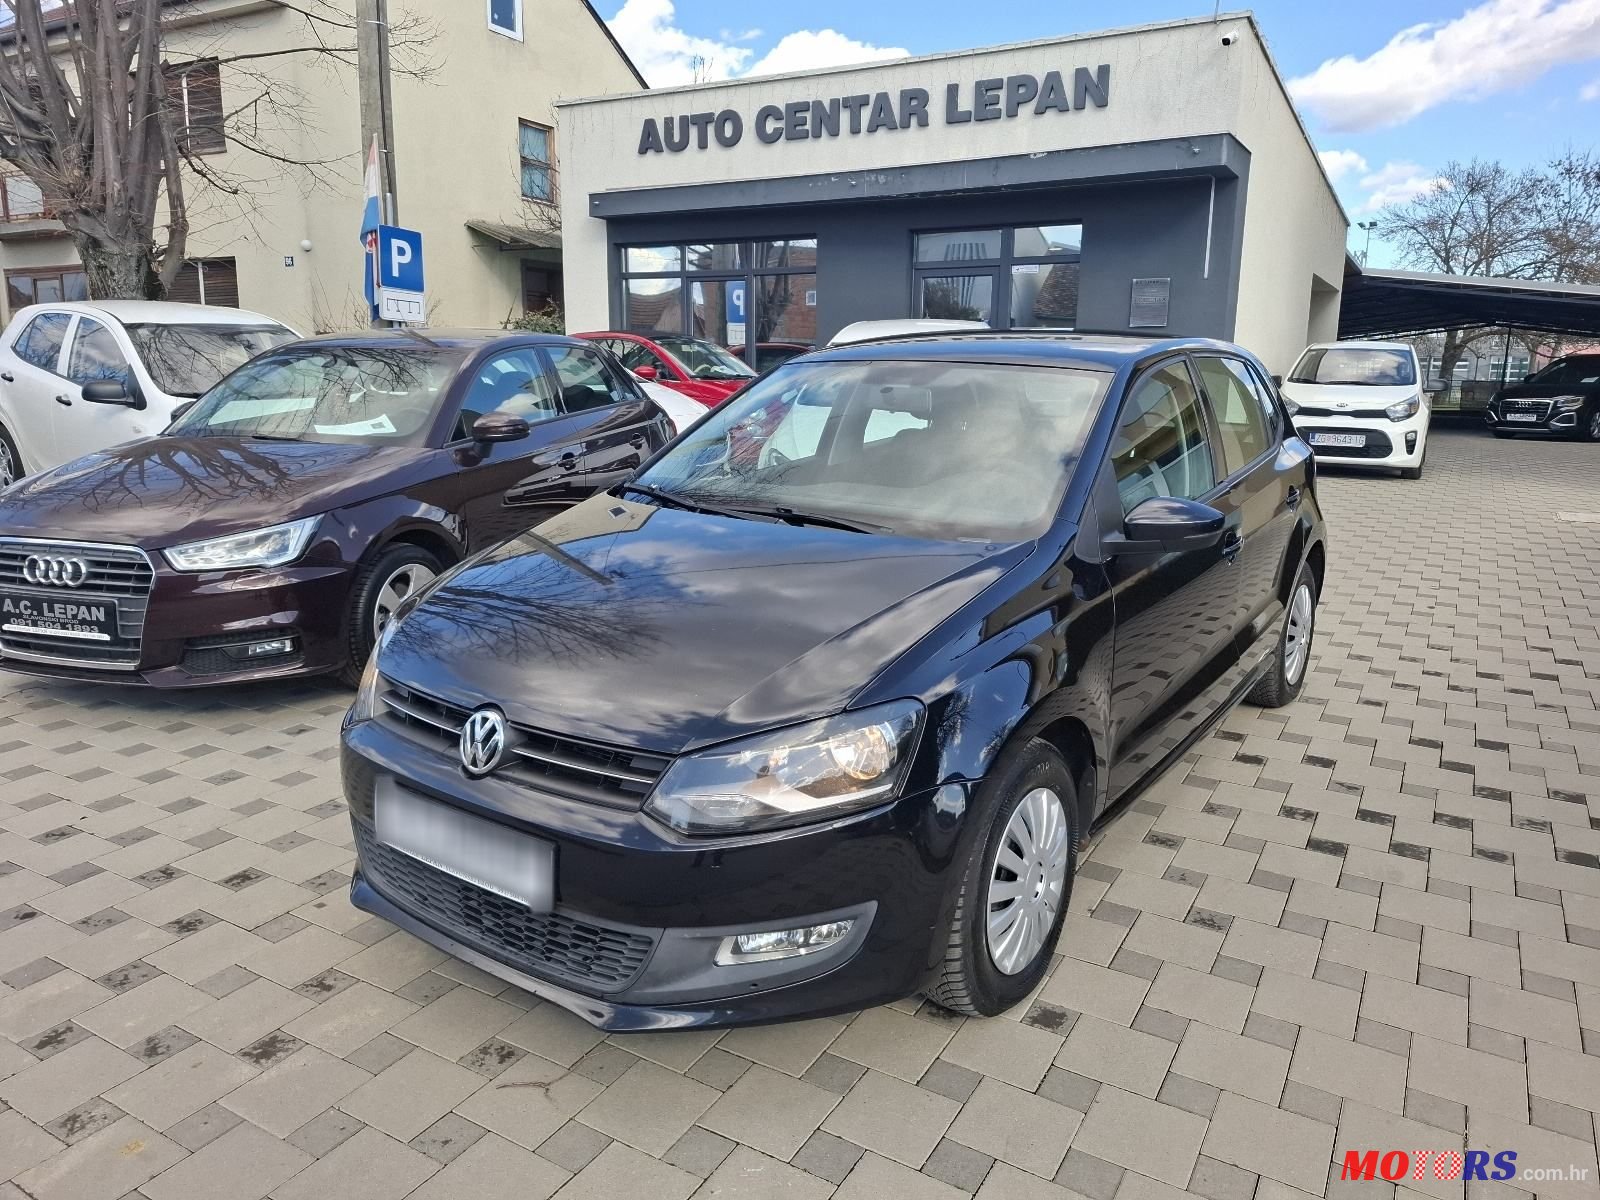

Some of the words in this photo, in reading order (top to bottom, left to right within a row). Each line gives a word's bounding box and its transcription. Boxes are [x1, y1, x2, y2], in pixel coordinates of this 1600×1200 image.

[638, 109, 743, 154] AUTO
[755, 87, 930, 144] CENTAR
[946, 64, 1110, 124] LEPAN
[391, 238, 412, 277] P
[2, 598, 38, 615] A.C.
[42, 602, 105, 621] LEPAN
[10, 617, 32, 626] 091
[65, 623, 99, 634] 1893
